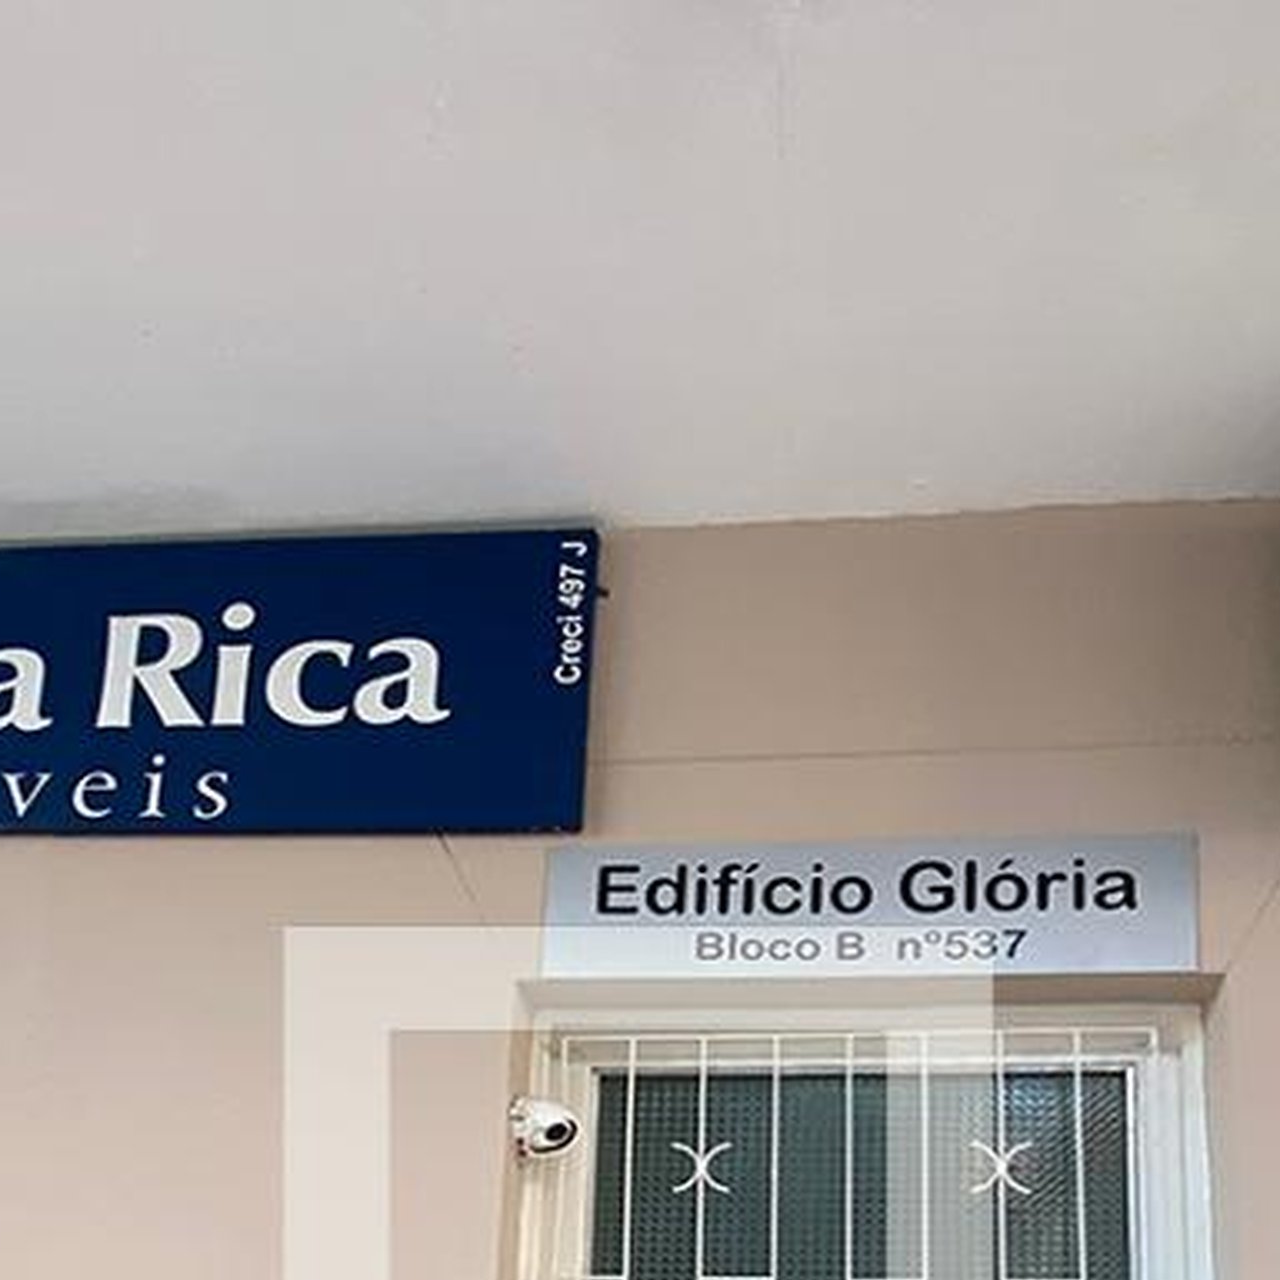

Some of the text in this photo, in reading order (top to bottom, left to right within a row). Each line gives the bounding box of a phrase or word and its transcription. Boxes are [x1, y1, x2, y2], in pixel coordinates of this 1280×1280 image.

[553, 541, 588, 685] Creci 497 J
[95, 602, 451, 730] Rica
[595, 858, 1139, 916] Edifício Glória
[695, 931, 821, 962] Bloco
[836, 932, 866, 960] B
